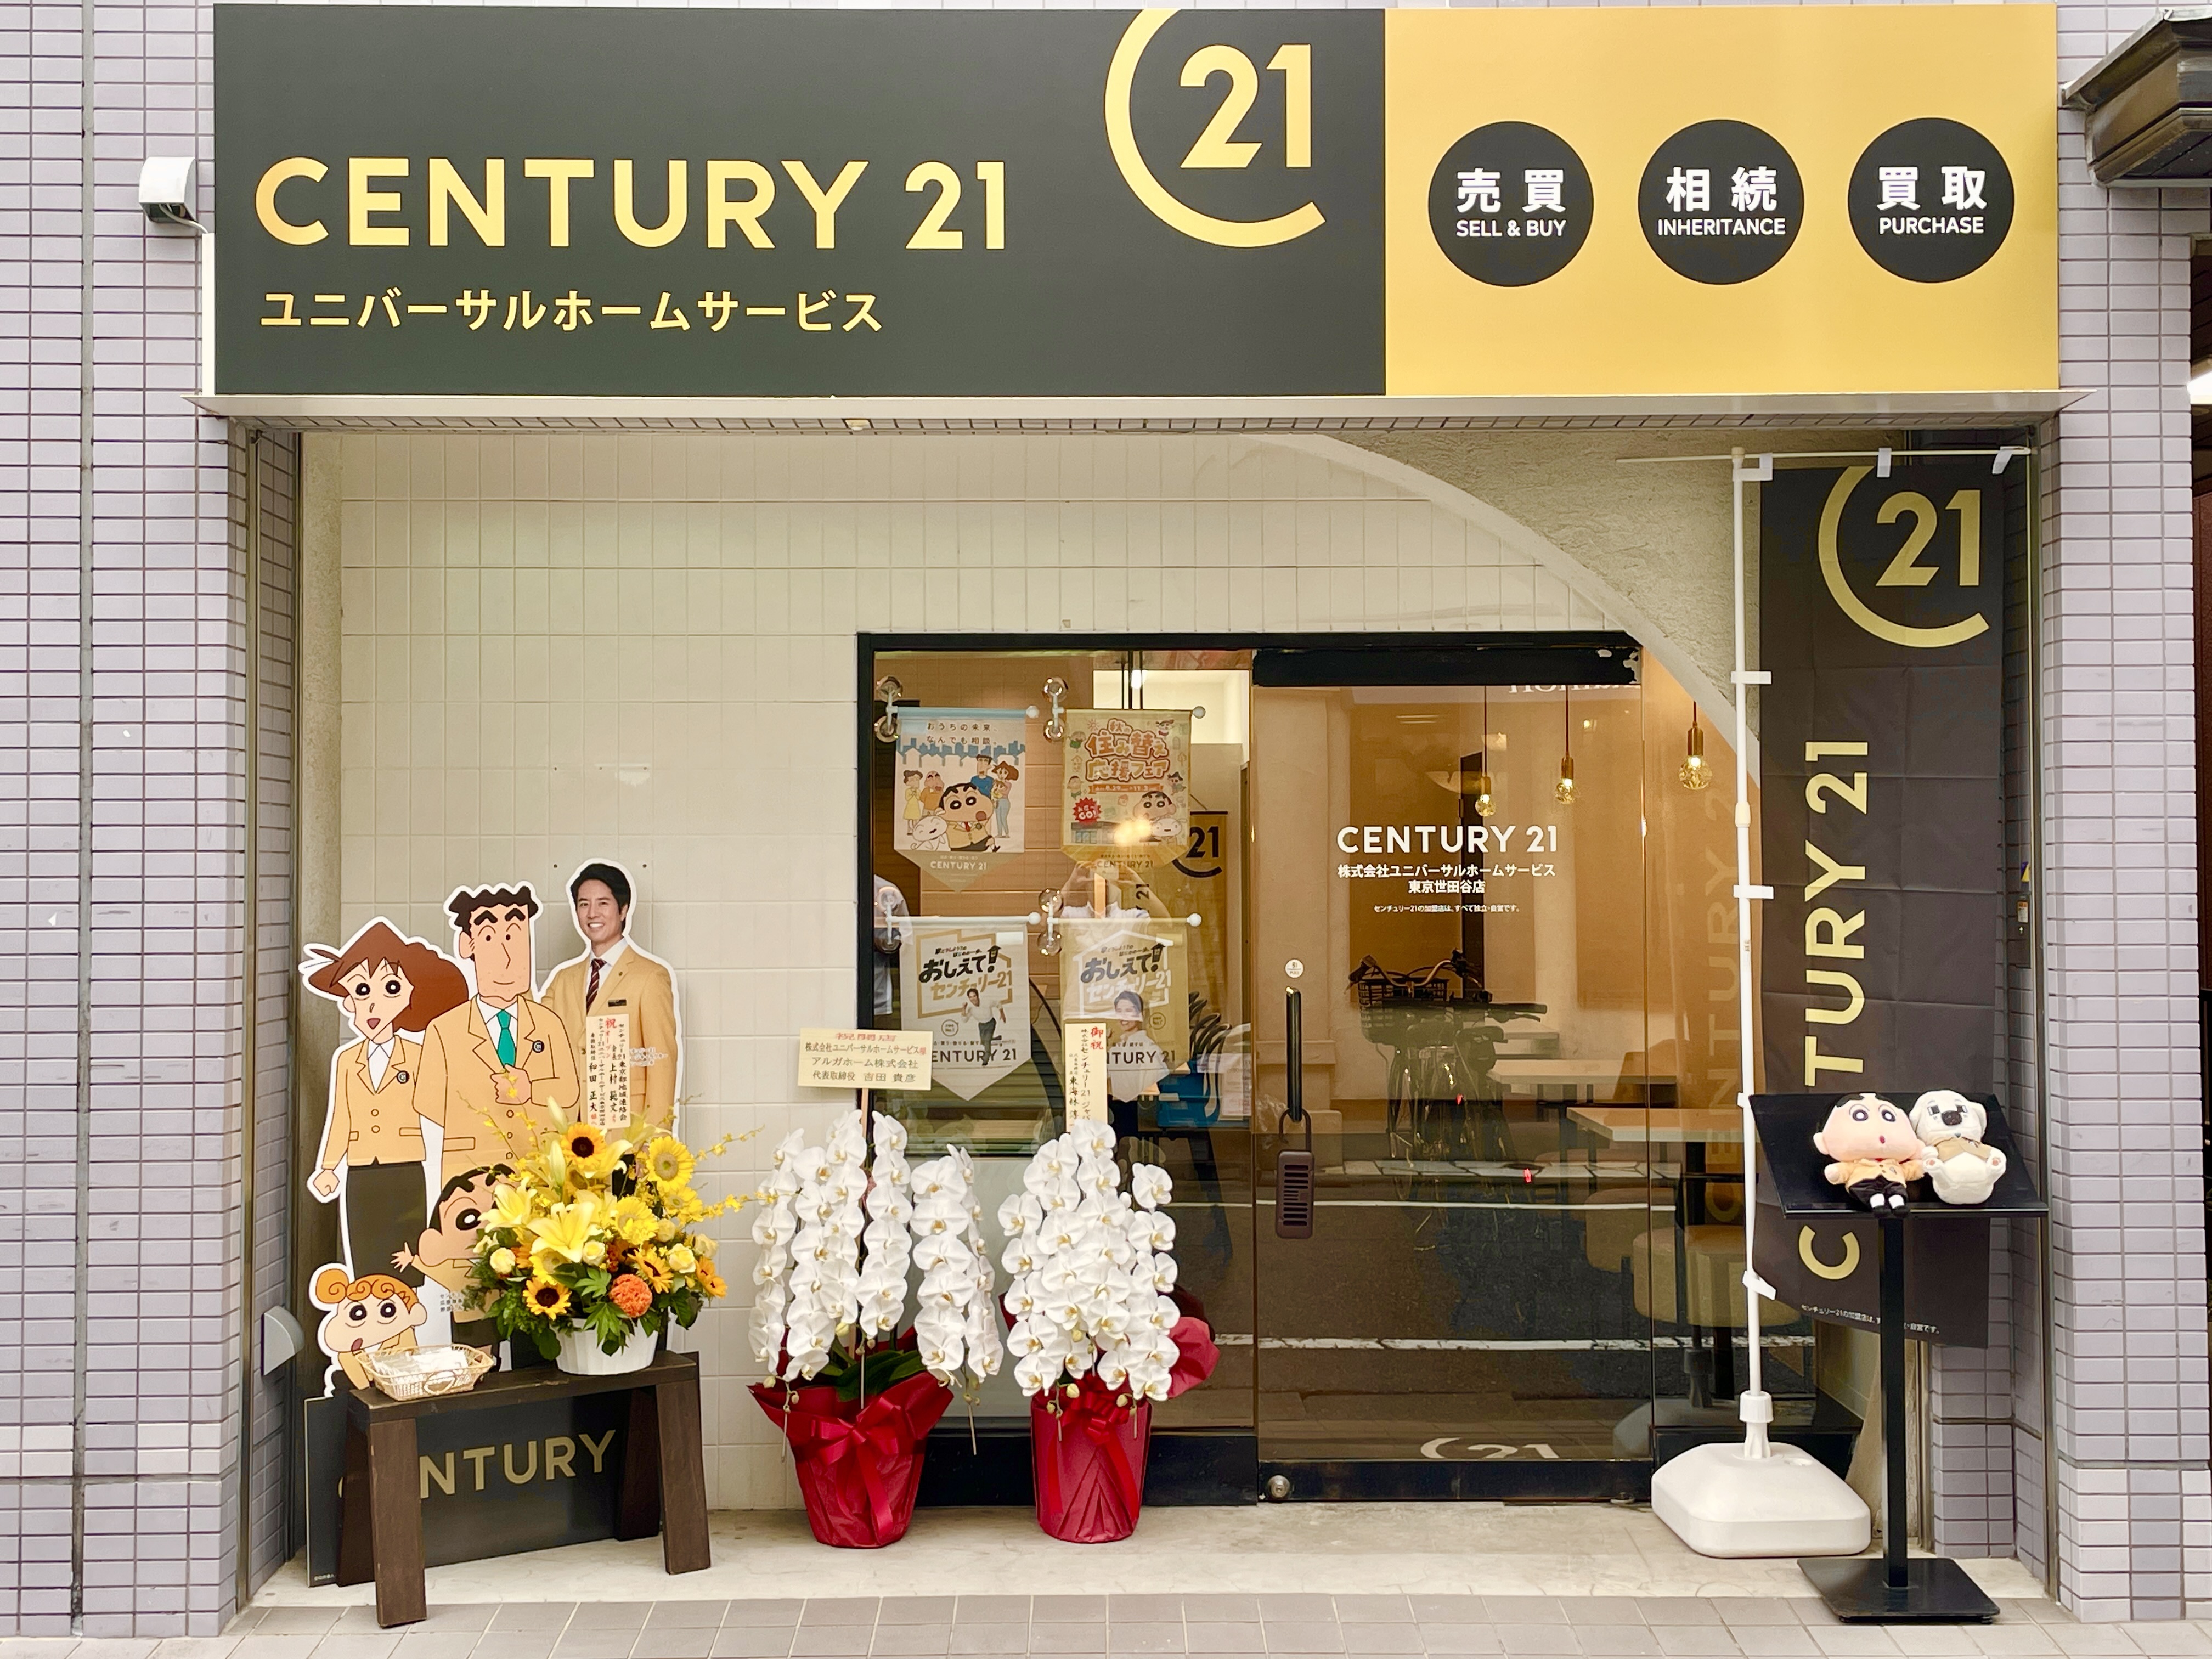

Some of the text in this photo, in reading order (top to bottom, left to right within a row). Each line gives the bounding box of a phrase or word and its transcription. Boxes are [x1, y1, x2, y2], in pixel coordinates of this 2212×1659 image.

[1457, 168, 1566, 213] 売買
[1666, 166, 1777, 212] 相続
[1877, 166, 1987, 211] 買取
[256, 157, 1005, 249] CENTURY 21
[1457, 219, 1566, 237] SELL & BUY
[1658, 218, 1786, 236] INHERITANCE
[1880, 216, 1984, 234] PURCHASE
[261, 286, 882, 333] ユニバーサルホームサービス
[1086, 730, 1167, 757] 住み替え
[1087, 759, 1169, 781] 応援フェア
[1805, 742, 1868, 814] 21
[1337, 825, 1557, 853] CENTURY 21
[930, 861, 976, 870] CENTURY
[1338, 864, 1556, 878] 株式会社ユニバーサルホームサービス
[1135, 883, 1150, 900] 21
[1408, 879, 1486, 894] 東京世田谷店
[812, 1057, 919, 1069] アルガホーム株式会社
[932, 1048, 1017, 1063] ENTURY 21
[1161, 1050, 1176, 1062] 21
[1798, 840, 1865, 1280] CTURY
[419, 1430, 616, 1499] NTURY
